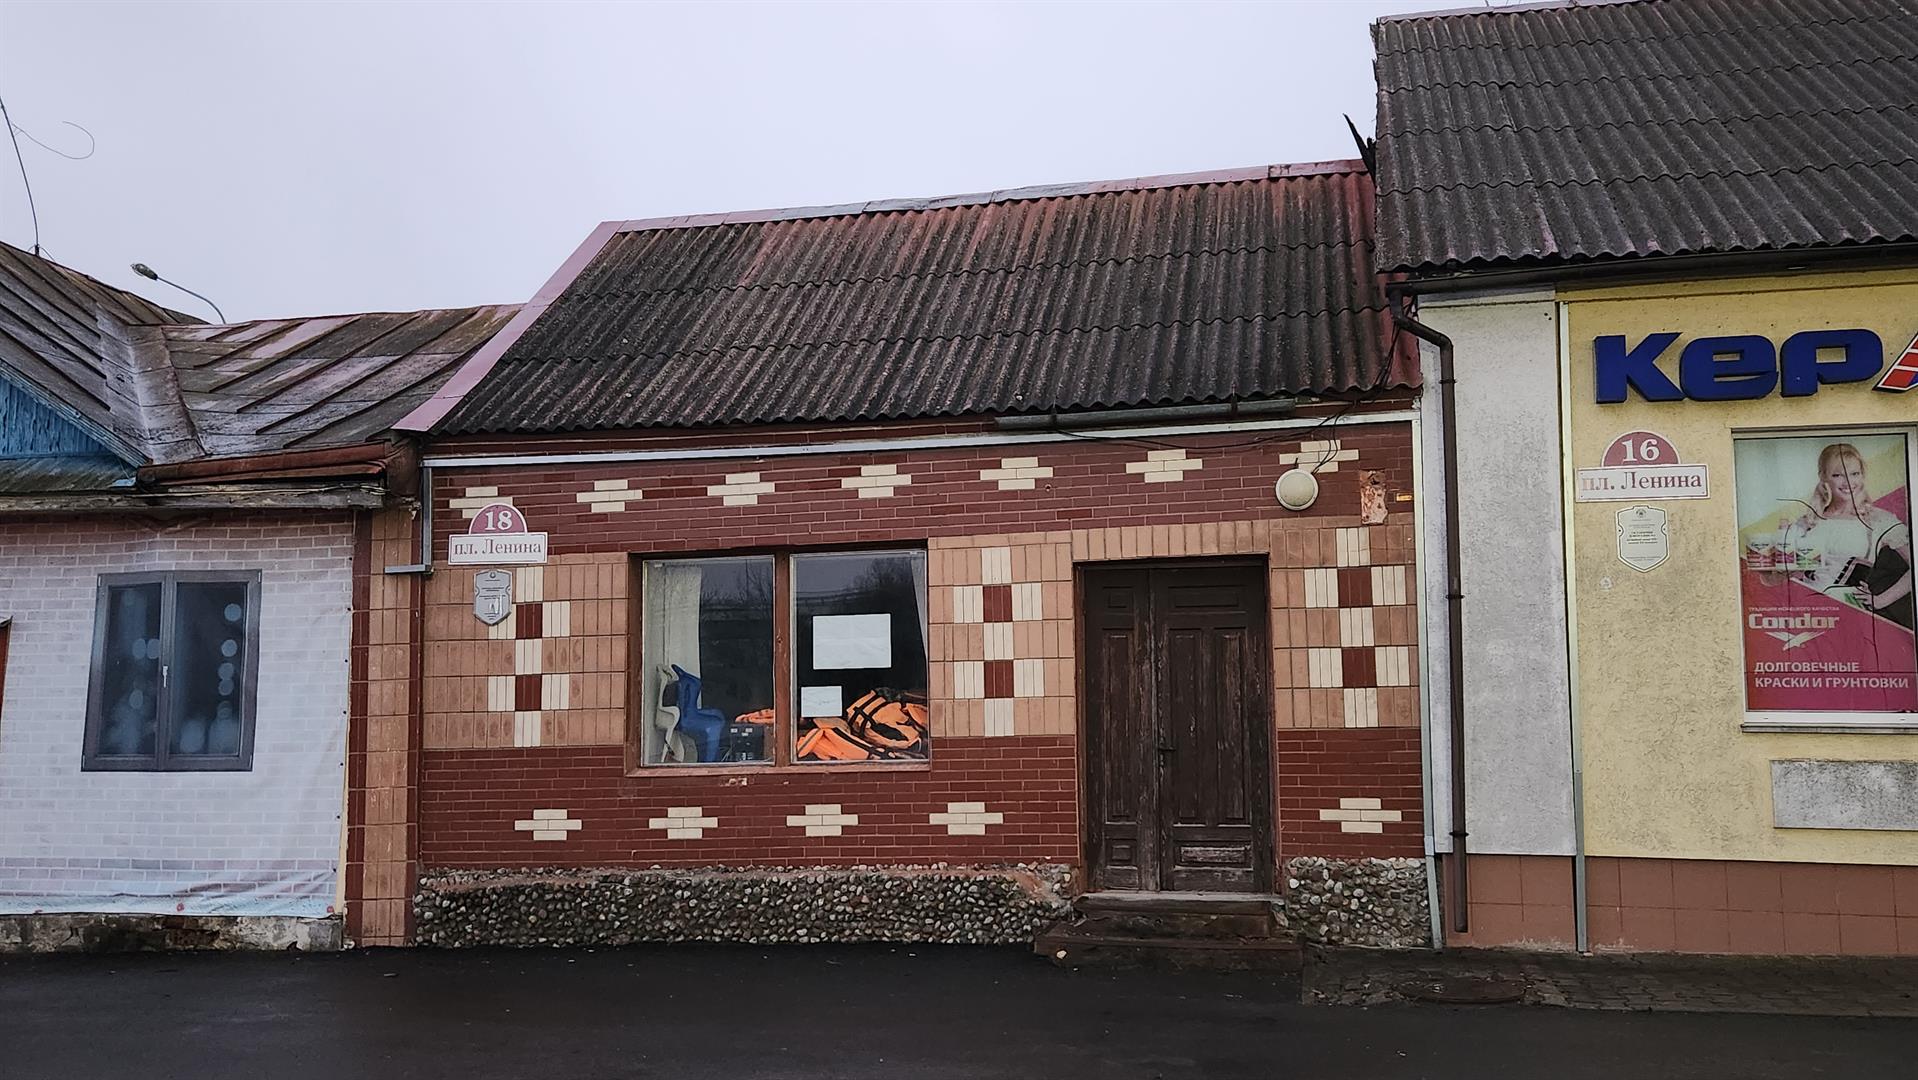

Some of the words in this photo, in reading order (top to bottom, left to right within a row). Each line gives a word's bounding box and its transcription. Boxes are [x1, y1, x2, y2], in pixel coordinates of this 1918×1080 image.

[1622, 438, 1660, 462] 16
[1582, 477, 1615, 491] пл.
[1621, 471, 1702, 490] Ленина
[485, 511, 513, 530] 18
[454, 542, 478, 555] пл.
[482, 539, 541, 554] Ленина
[1748, 613, 1840, 628] Condor
[1754, 662, 1860, 674] ДОЛГОВЕЧНЫЕ
[1755, 678, 1810, 688] КРАСКИ
[1812, 678, 1822, 688] И
[1826, 678, 1909, 688] ГРУНТОВКИ
